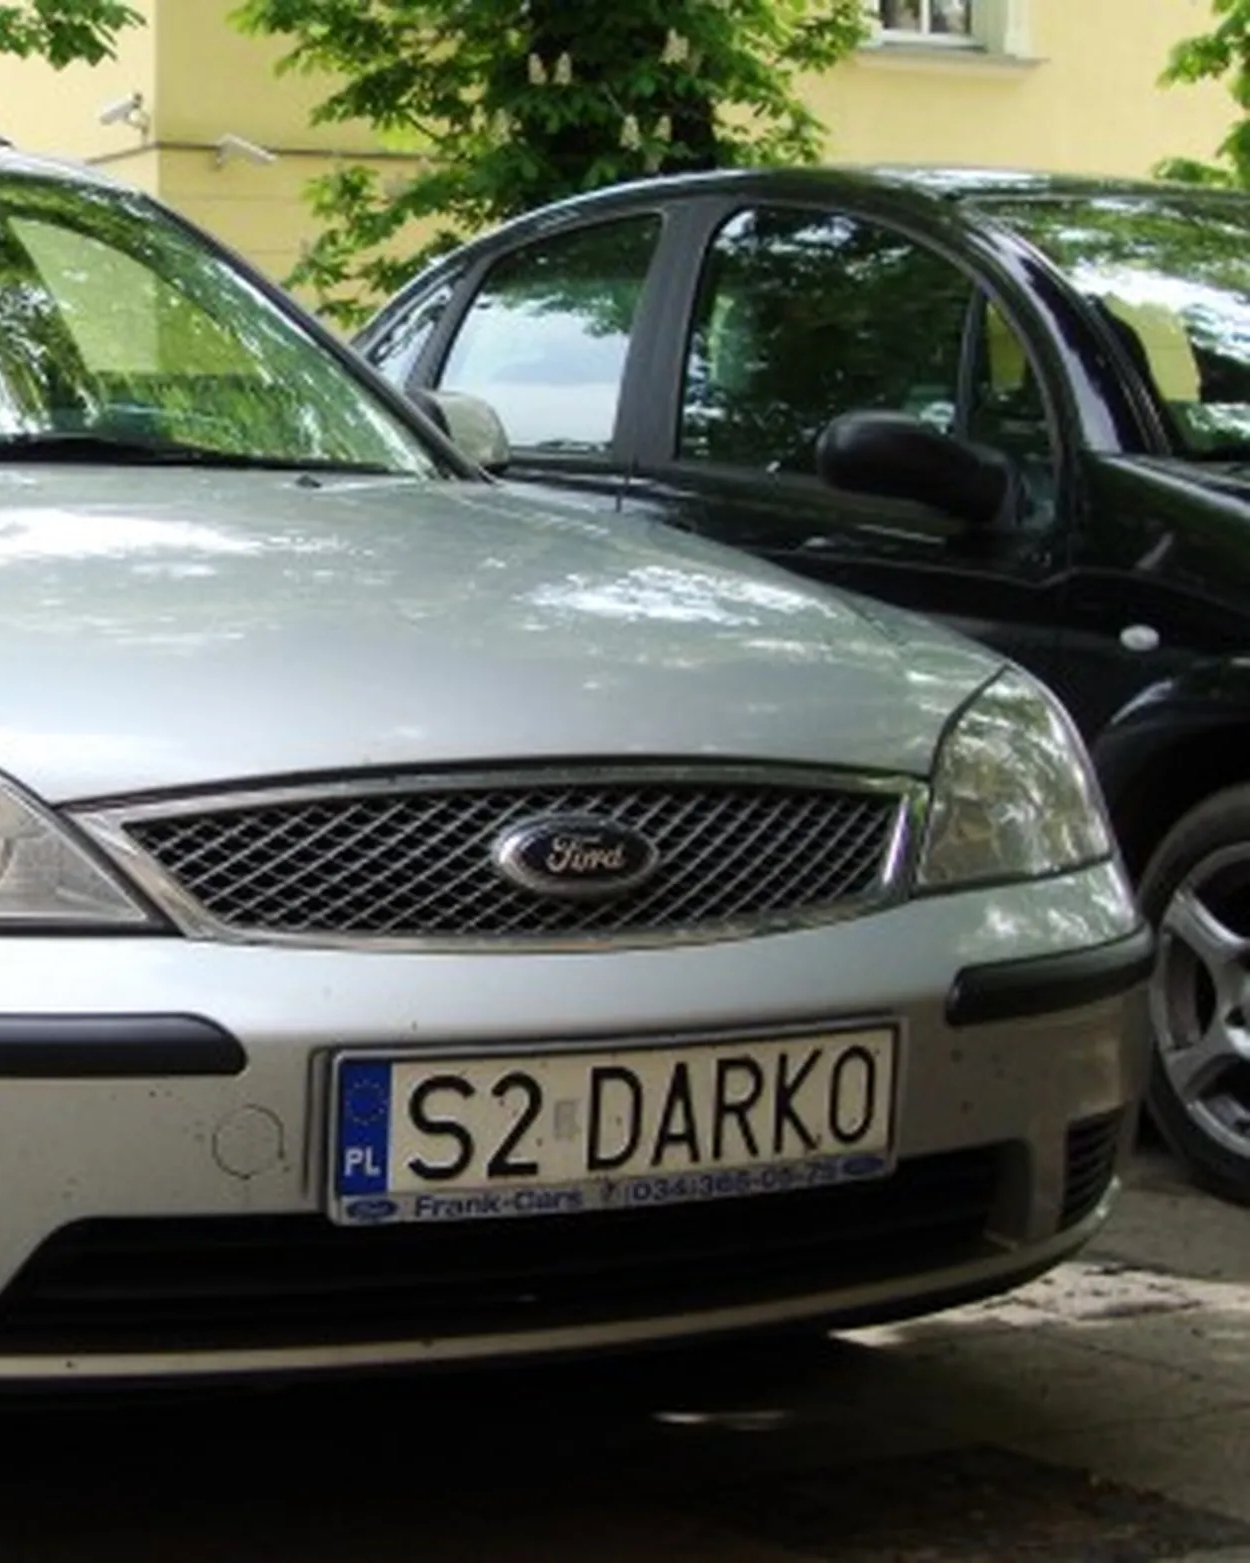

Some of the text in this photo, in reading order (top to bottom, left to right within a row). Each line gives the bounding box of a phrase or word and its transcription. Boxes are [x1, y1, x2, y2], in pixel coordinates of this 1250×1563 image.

[547, 836, 626, 872] Ford
[408, 1045, 876, 1181] S2 DARKO
[346, 1147, 381, 1177] PL
